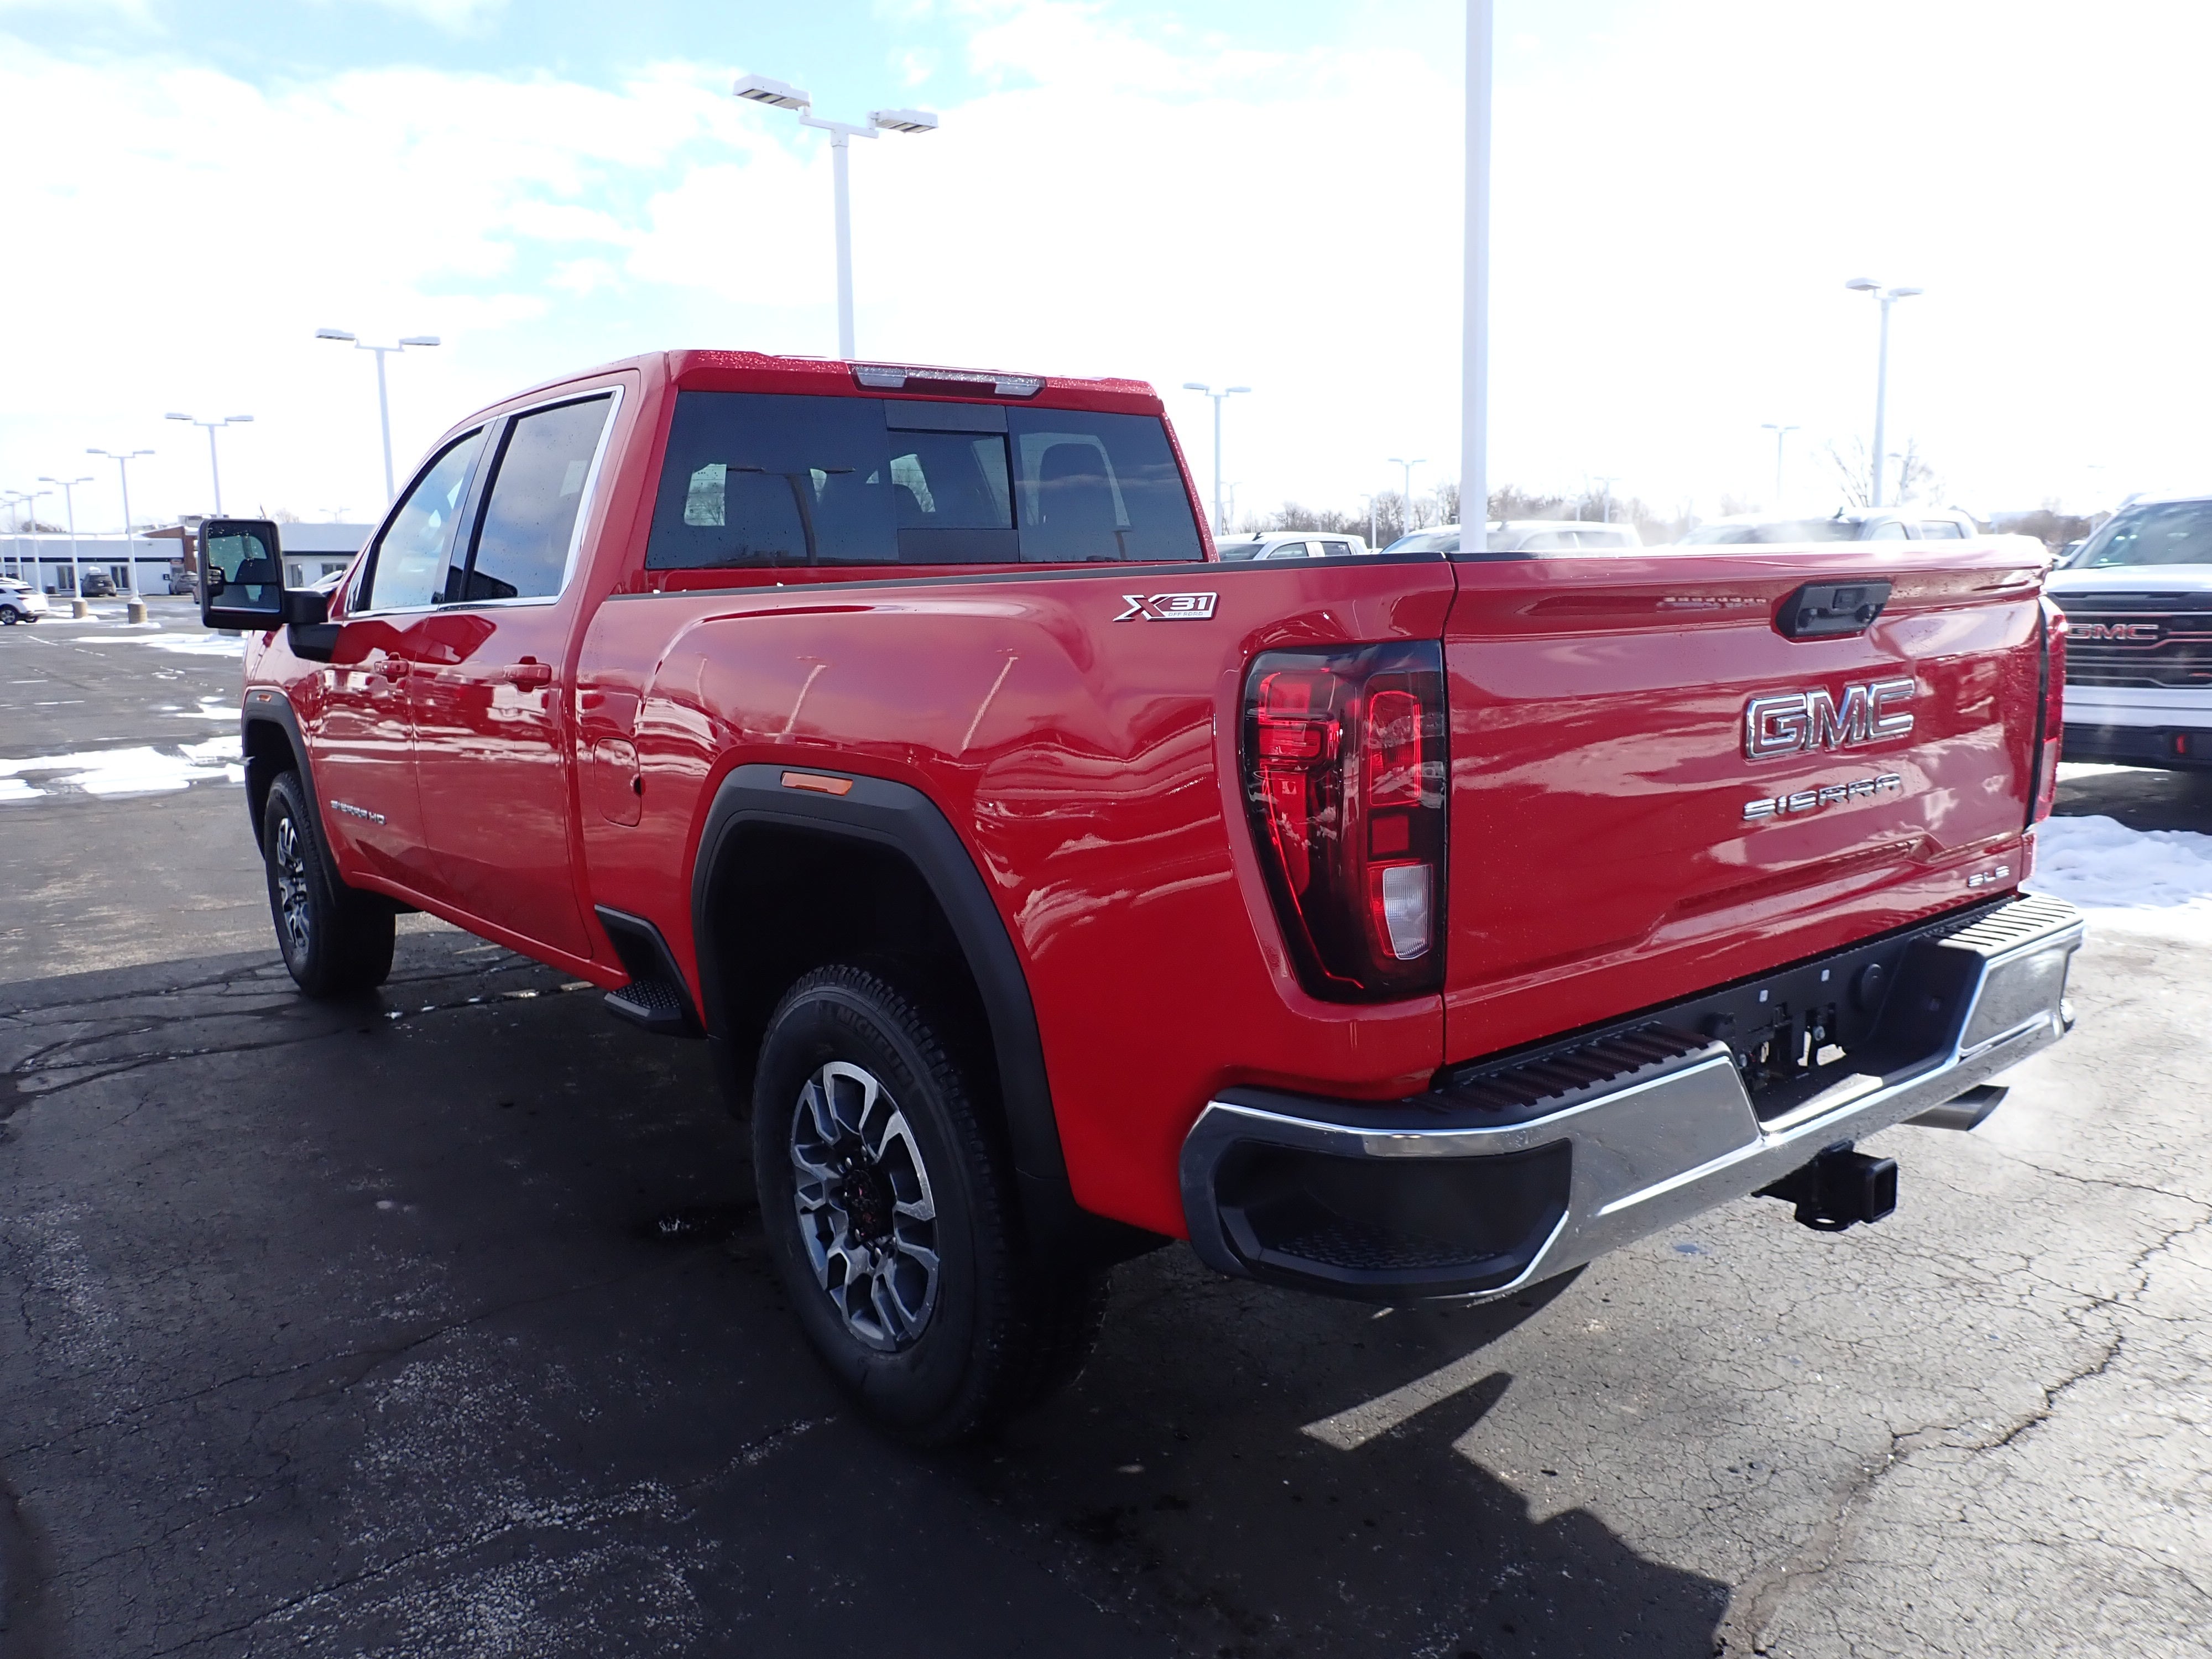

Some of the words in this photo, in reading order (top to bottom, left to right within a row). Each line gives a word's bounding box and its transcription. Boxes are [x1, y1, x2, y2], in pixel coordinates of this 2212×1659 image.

[1112, 592, 1218, 621] X31
[2064, 623, 2158, 639] GMC
[1746, 679, 1915, 758] GMC
[1743, 773, 1901, 821] SIERRA
[1968, 865, 2010, 887] SLE
[836, 1004, 915, 1089] MICHELIN
